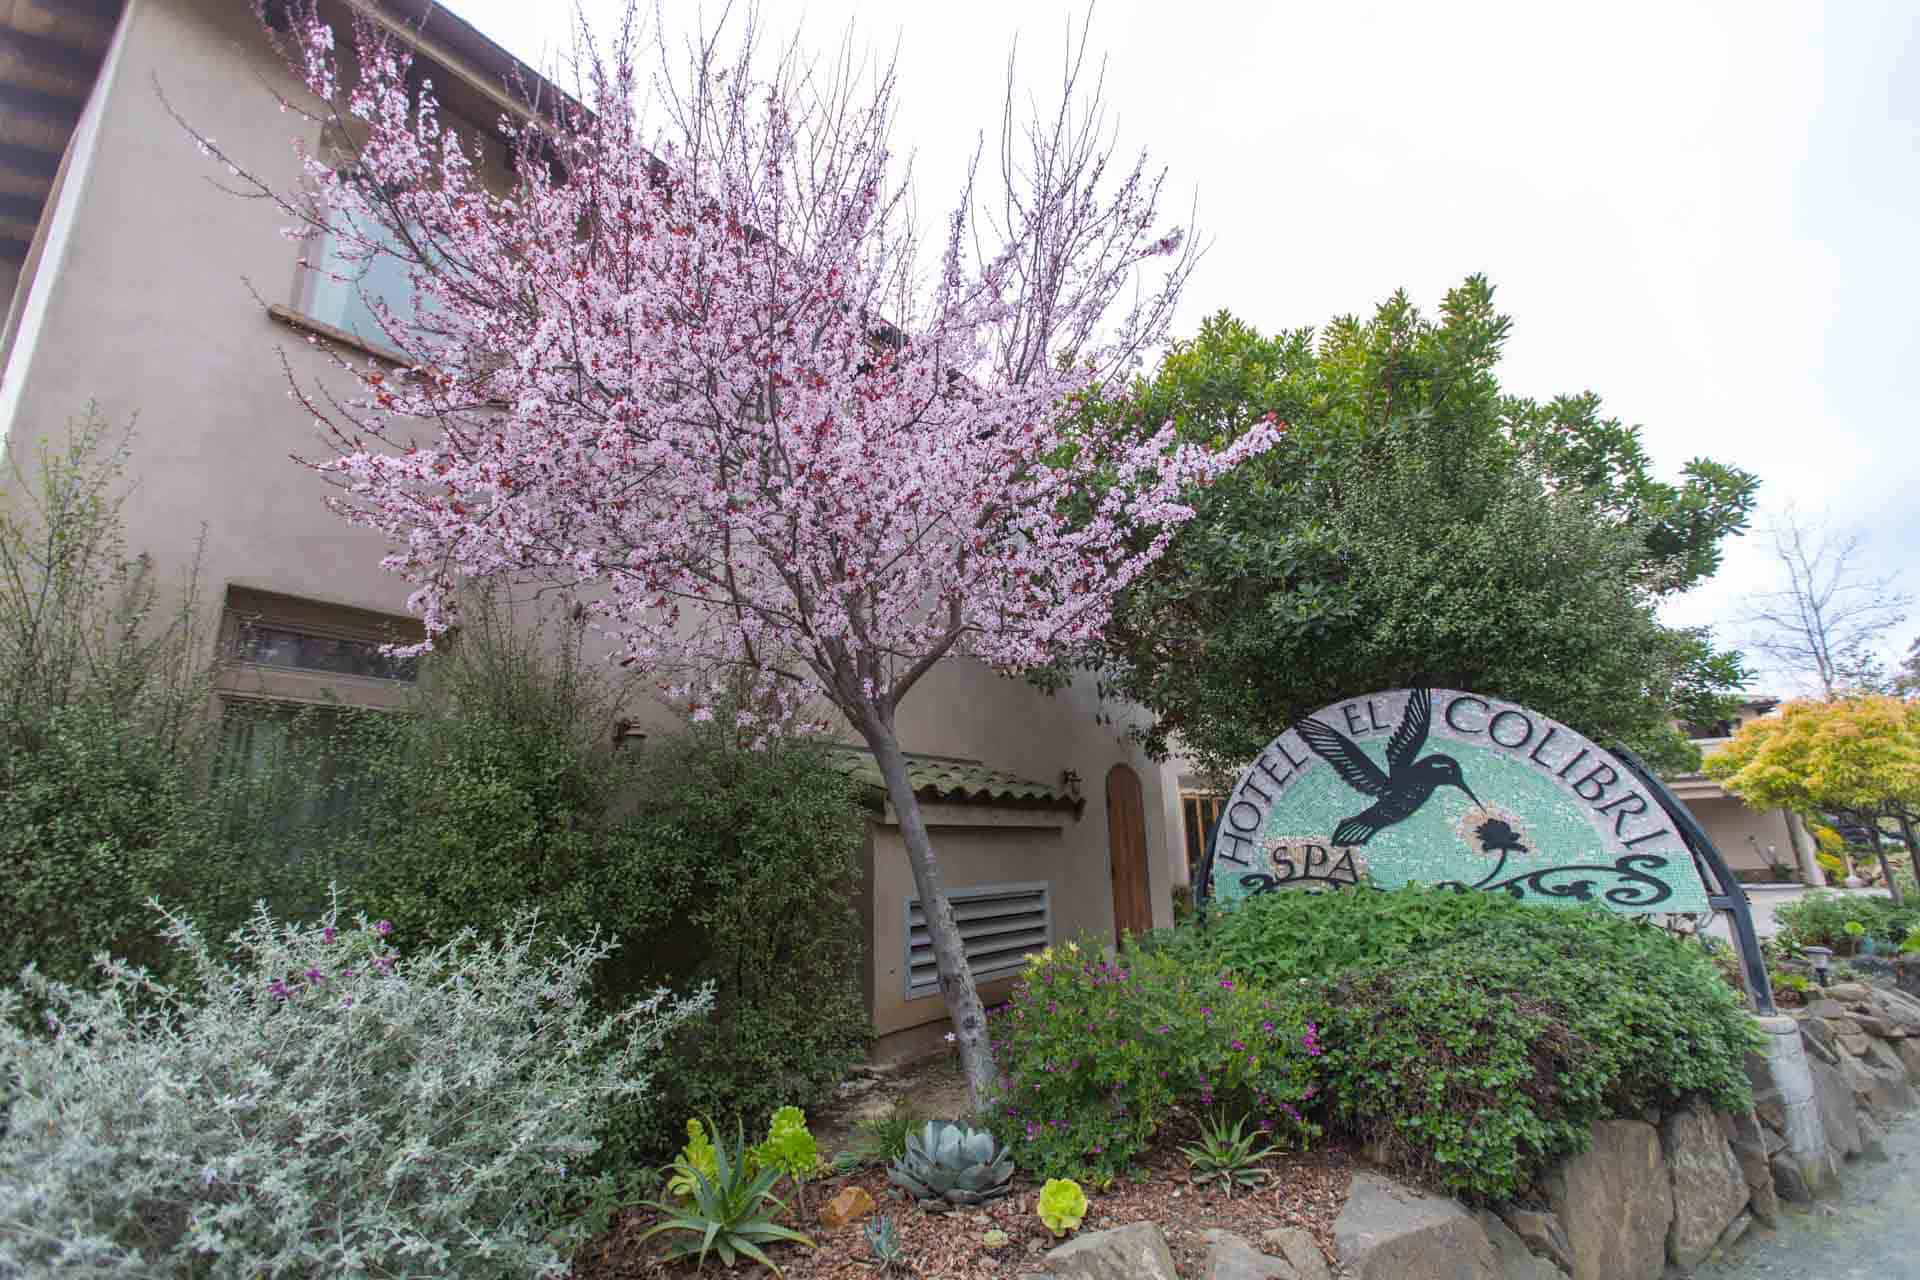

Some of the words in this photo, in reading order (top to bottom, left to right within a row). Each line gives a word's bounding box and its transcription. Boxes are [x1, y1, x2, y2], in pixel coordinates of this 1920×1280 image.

[1219, 742, 1309, 867] HOTEL
[1343, 700, 1390, 736] EL
[1445, 696, 1669, 850] COLIBRI
[1272, 844, 1360, 883] SPA
